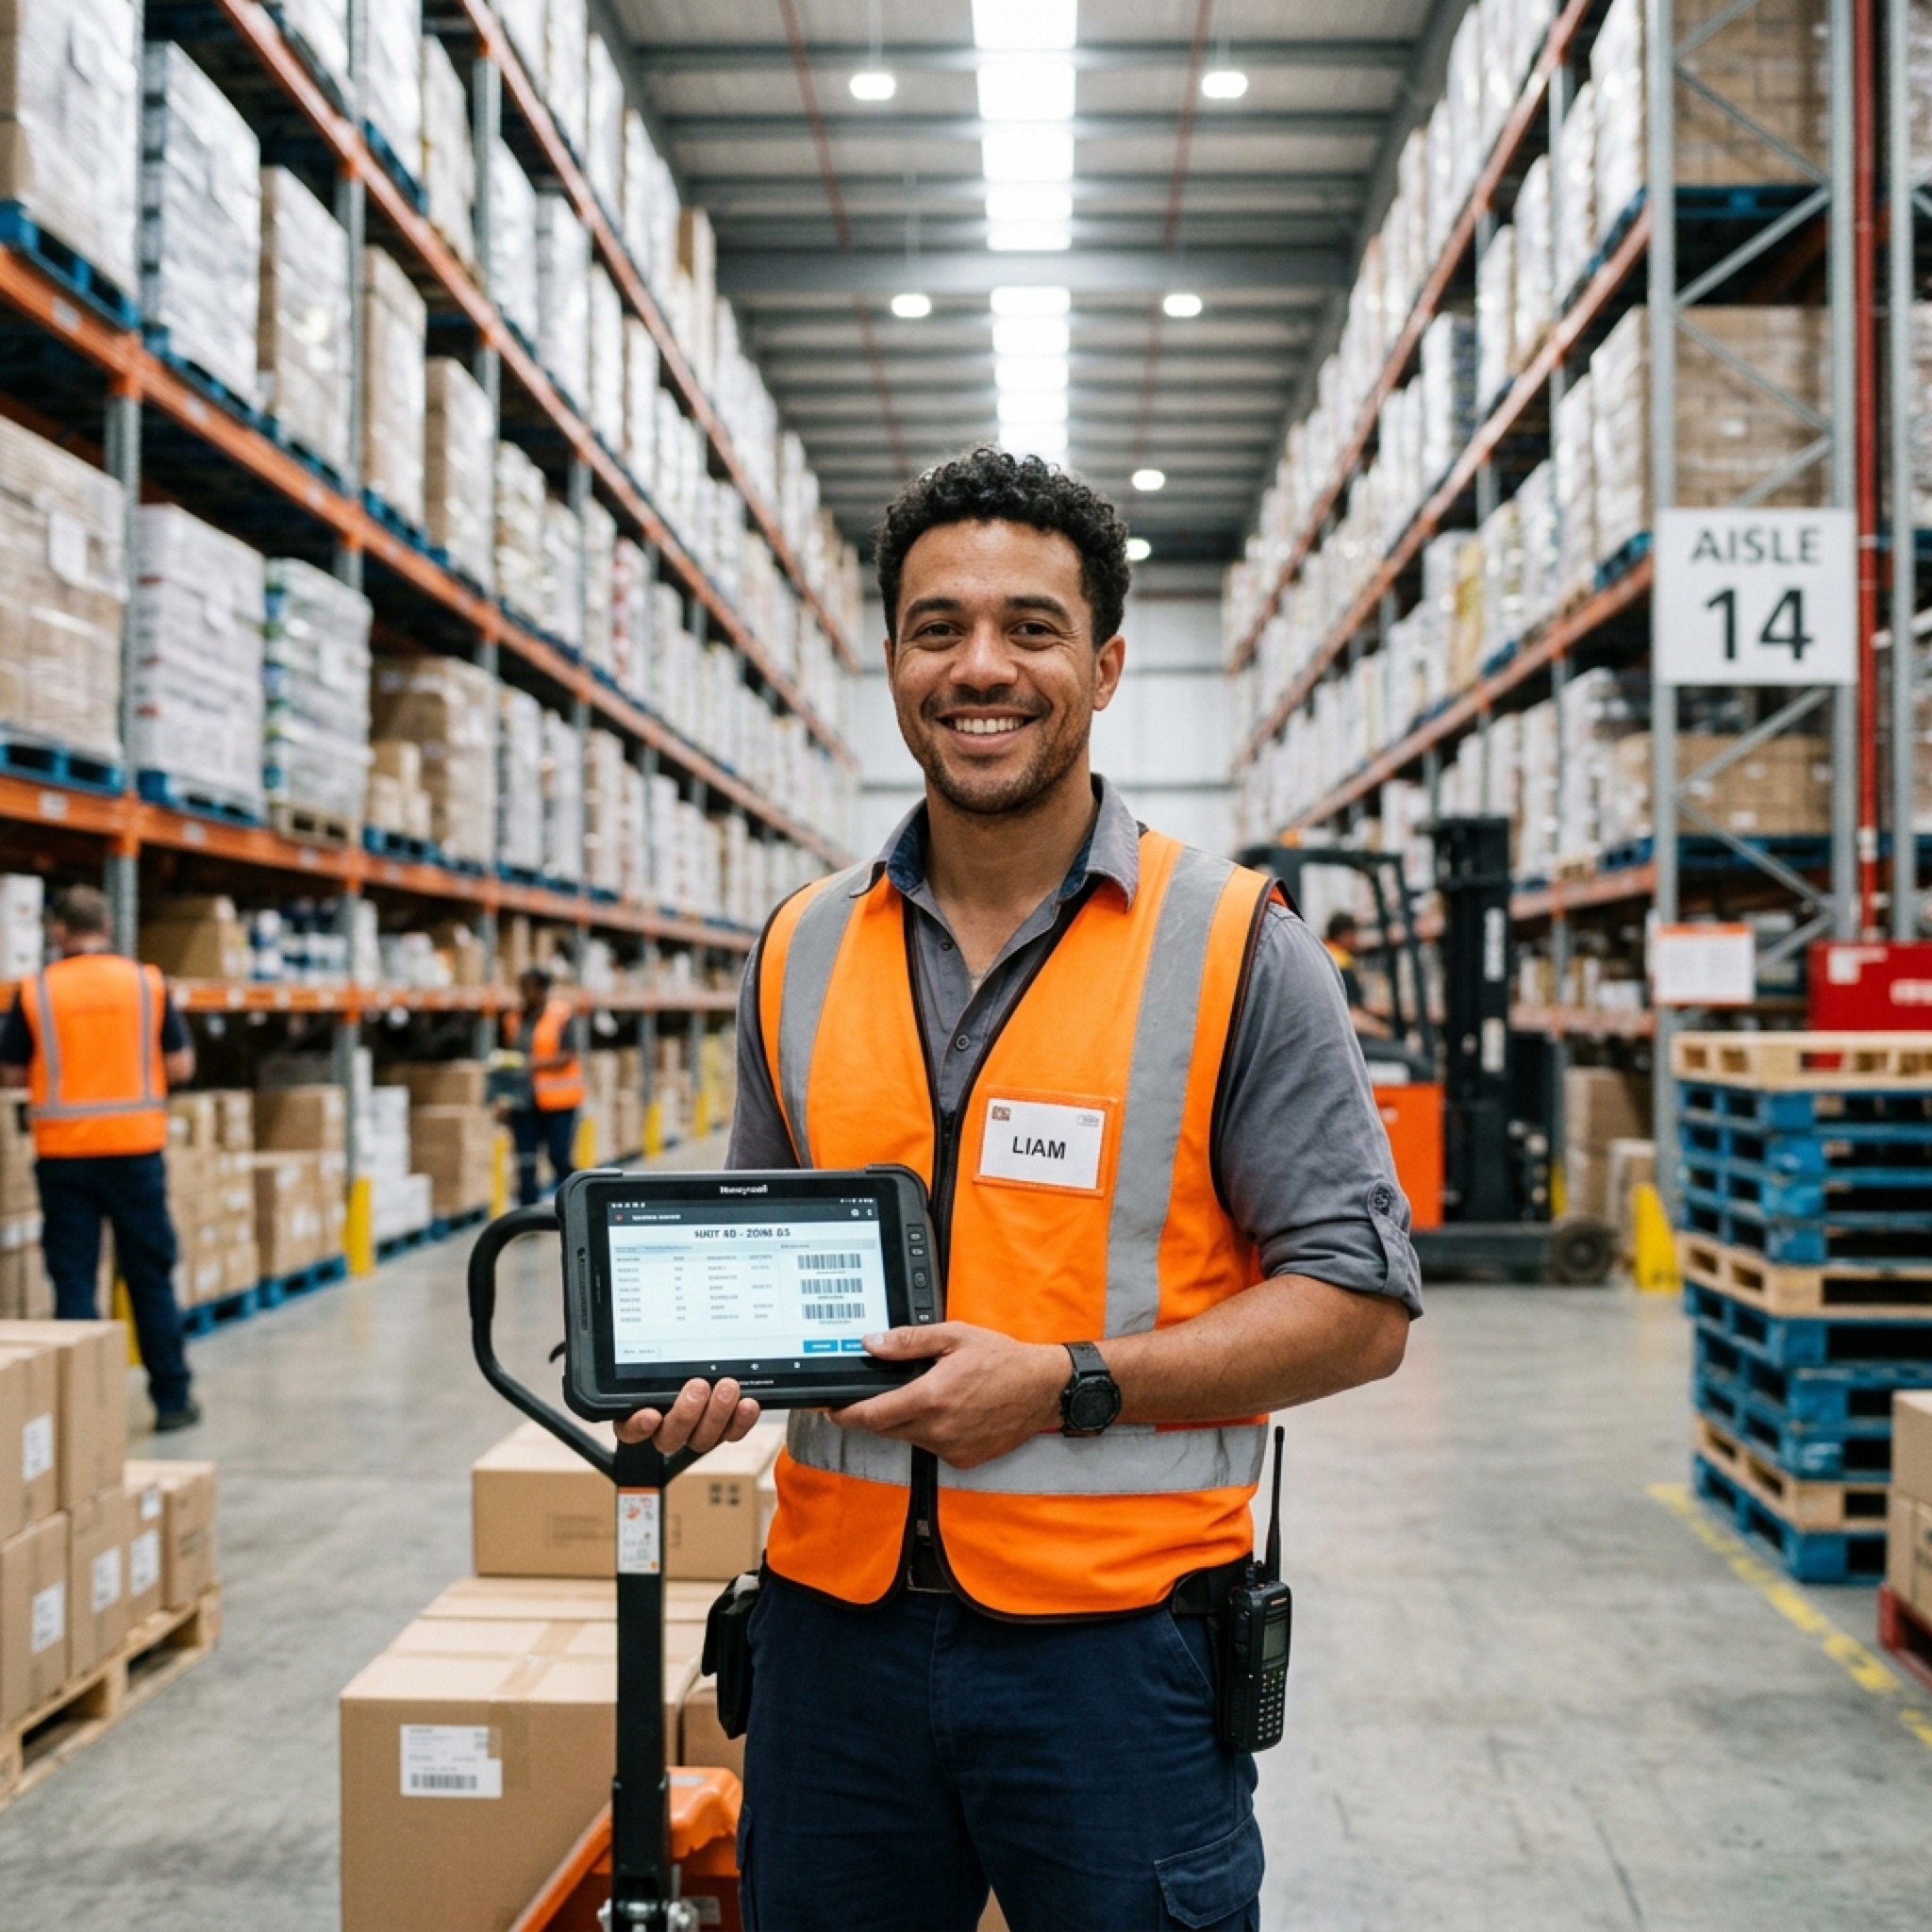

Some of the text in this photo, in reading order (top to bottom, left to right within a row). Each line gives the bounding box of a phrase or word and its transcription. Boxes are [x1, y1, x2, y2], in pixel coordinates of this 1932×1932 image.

[1690, 525, 1822, 565] AISLE
[1706, 586, 1813, 661] 14
[1012, 1136, 1067, 1159] LIAM
